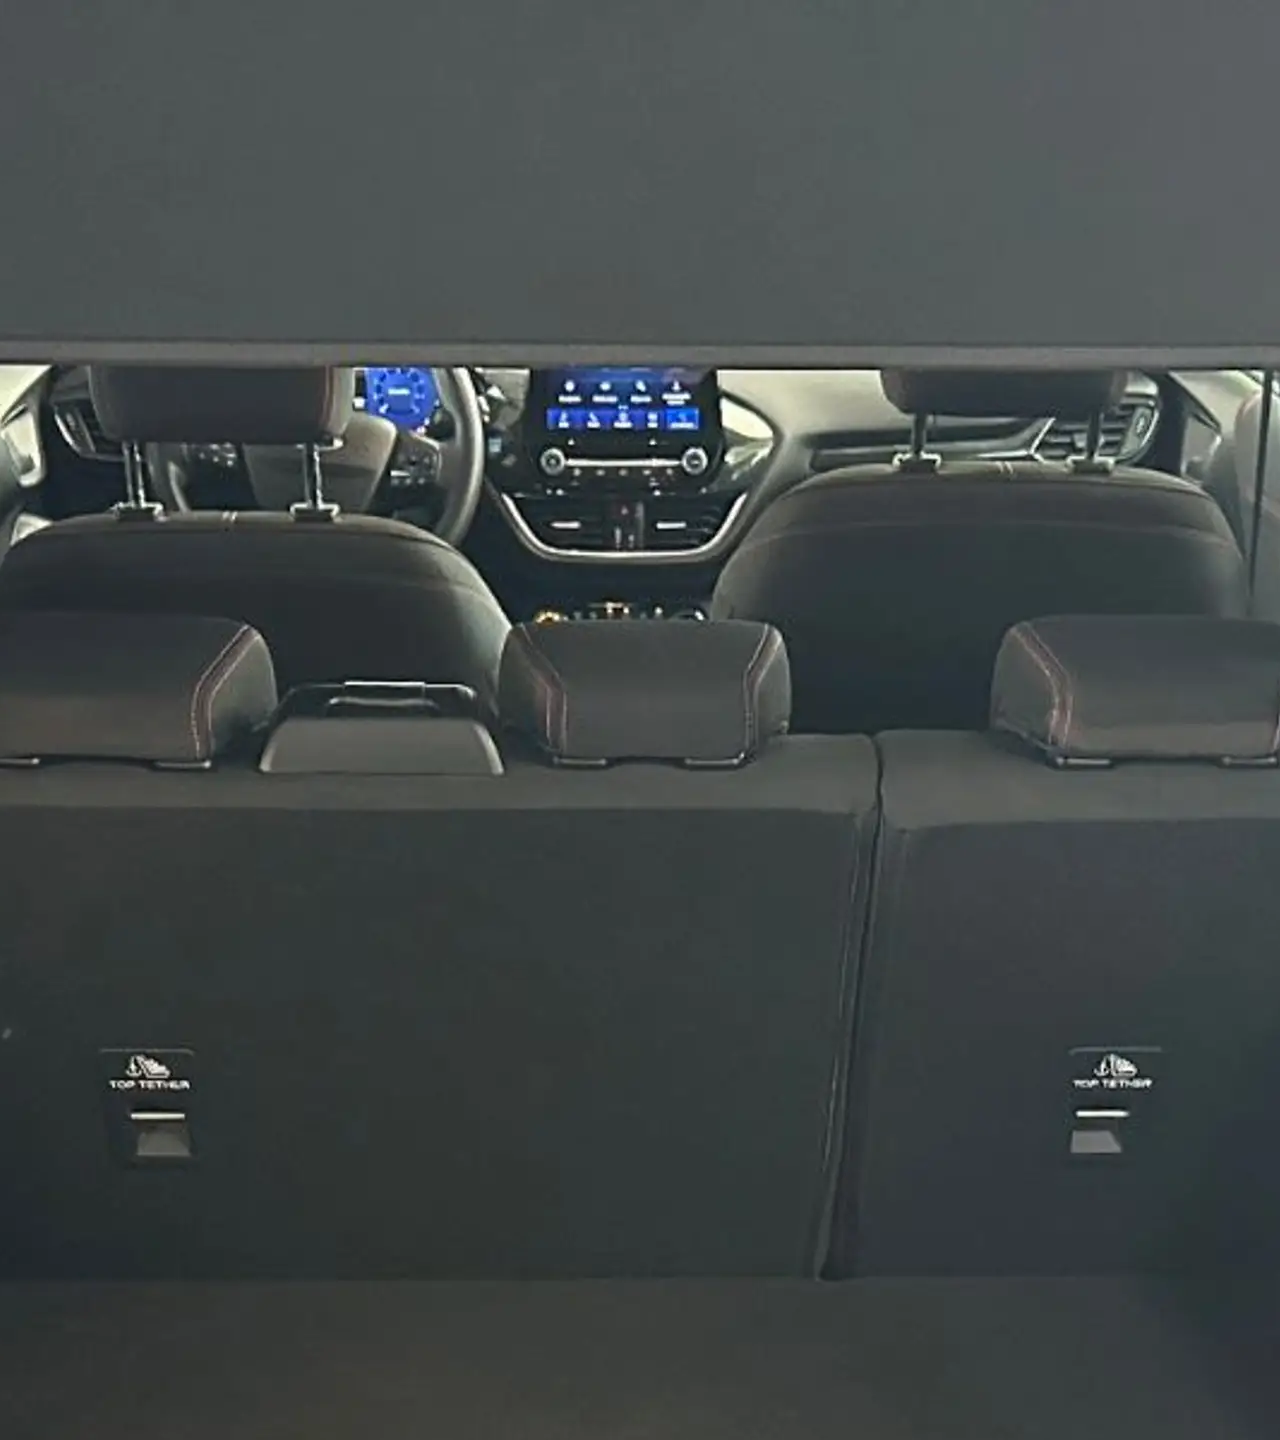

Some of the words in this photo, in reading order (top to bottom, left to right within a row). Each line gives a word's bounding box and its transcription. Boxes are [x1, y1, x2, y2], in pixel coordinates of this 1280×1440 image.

[109, 1079, 136, 1089] TOP
[138, 1079, 191, 1090] TETHER
[1073, 1078, 1100, 1088] TOP
